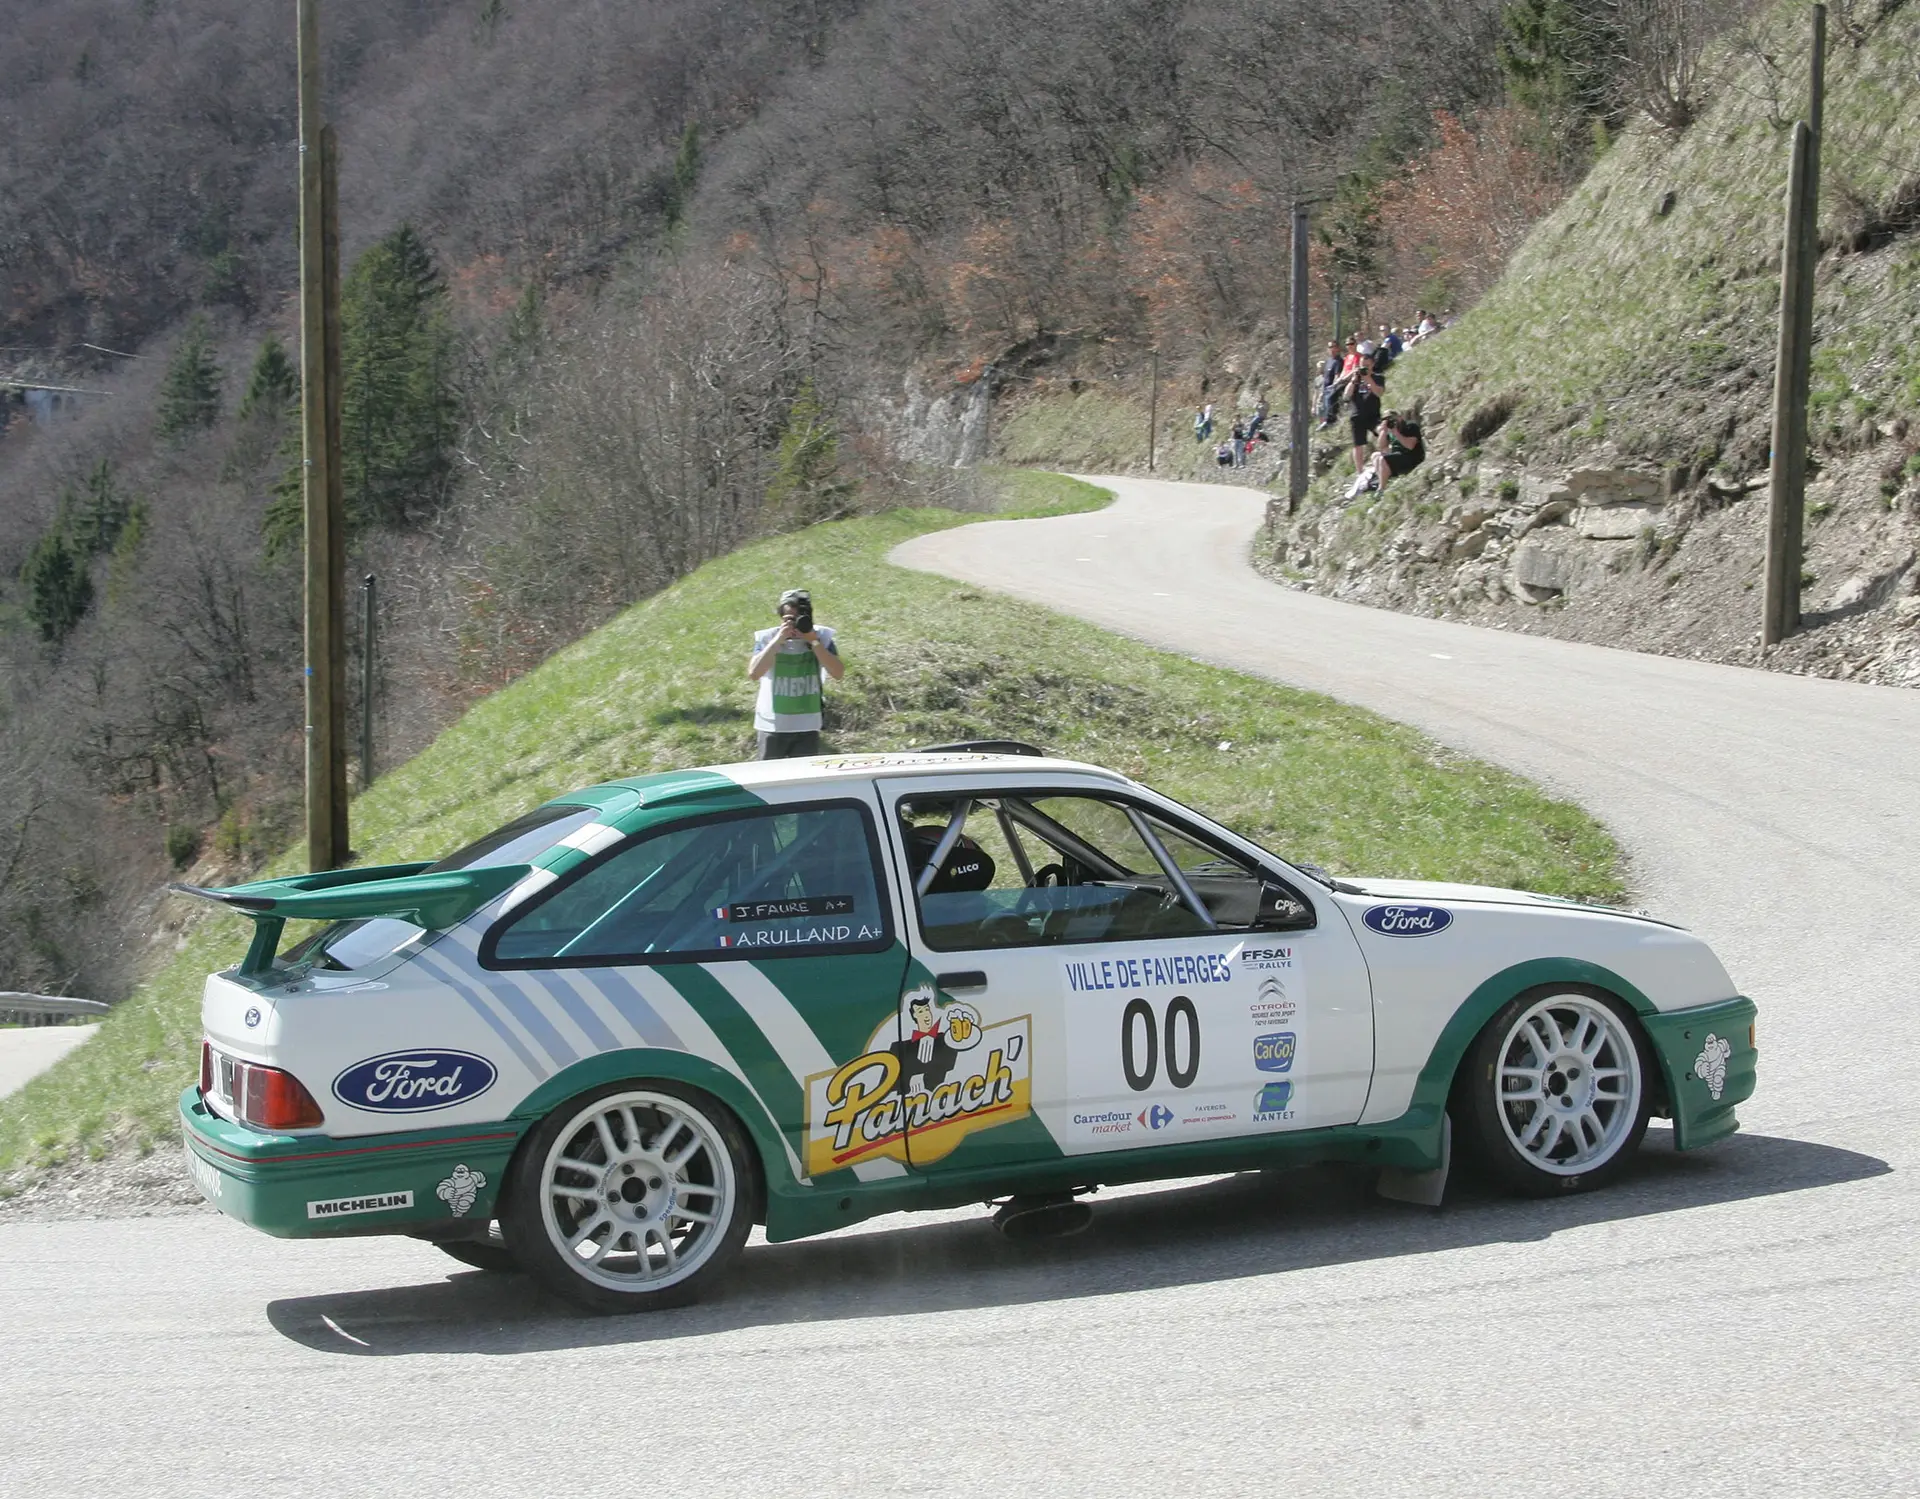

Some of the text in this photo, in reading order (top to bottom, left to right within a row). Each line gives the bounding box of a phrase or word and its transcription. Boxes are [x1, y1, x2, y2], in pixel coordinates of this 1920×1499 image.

[774, 675, 820, 697] MEDIA
[957, 863, 980, 875] LICO
[1381, 906, 1435, 930] Ford
[736, 924, 883, 946] A.RULLAND A+
[1241, 948, 1287, 961] FFSA
[1259, 961, 1292, 969] RALLYE
[1065, 953, 1231, 992] VILLE DE FAVERGES
[1121, 995, 1201, 1092] 00
[366, 1059, 463, 1102] Ford
[823, 1034, 1024, 1151] Panach'
[1073, 1111, 1133, 1124] Carrefour
[1252, 1111, 1295, 1122] NANTET
[1091, 1121, 1133, 1134] market
[315, 1195, 408, 1215] MICHELIN
